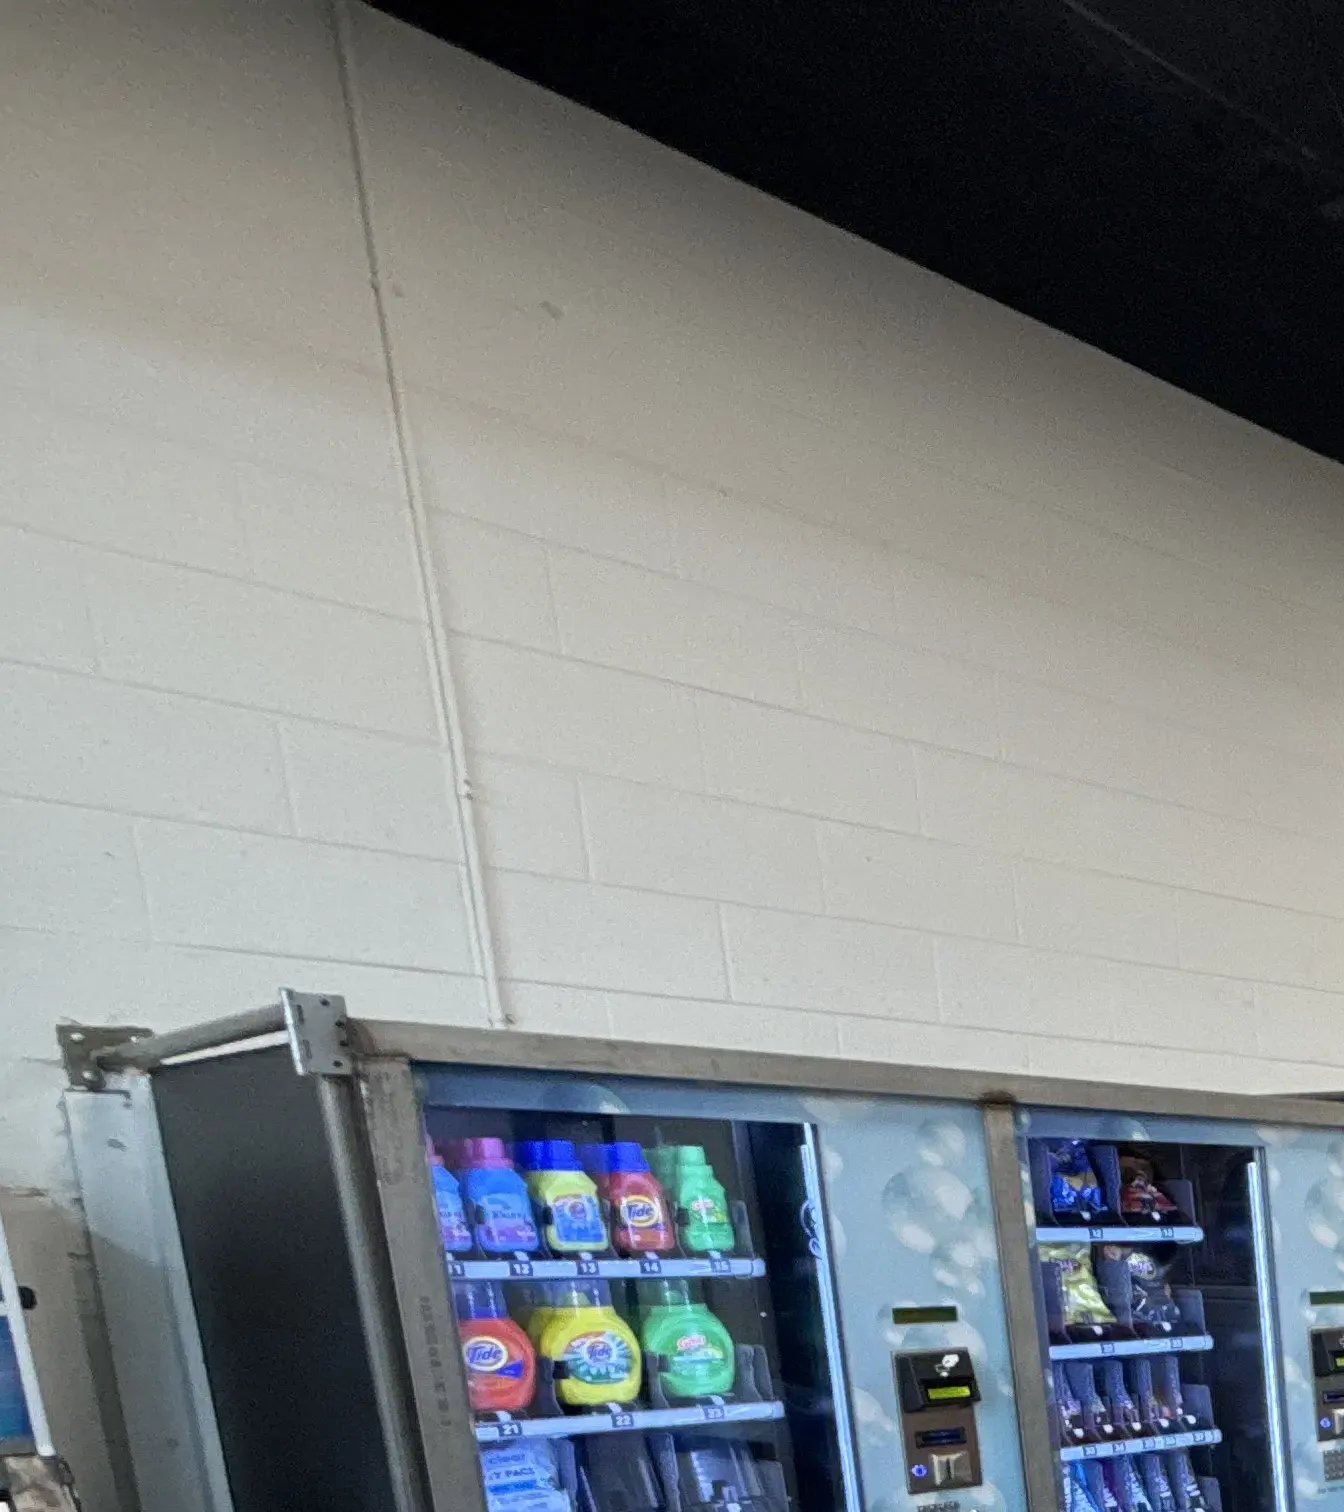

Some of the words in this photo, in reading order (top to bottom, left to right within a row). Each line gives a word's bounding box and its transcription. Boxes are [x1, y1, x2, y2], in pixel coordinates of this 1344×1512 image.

[626, 1203, 654, 1218] Tide
[512, 1263, 531, 1275] 12
[579, 1262, 597, 1274] 13
[643, 1261, 660, 1273] 14
[467, 1343, 503, 1366] Tide
[503, 1422, 520, 1435] 21
